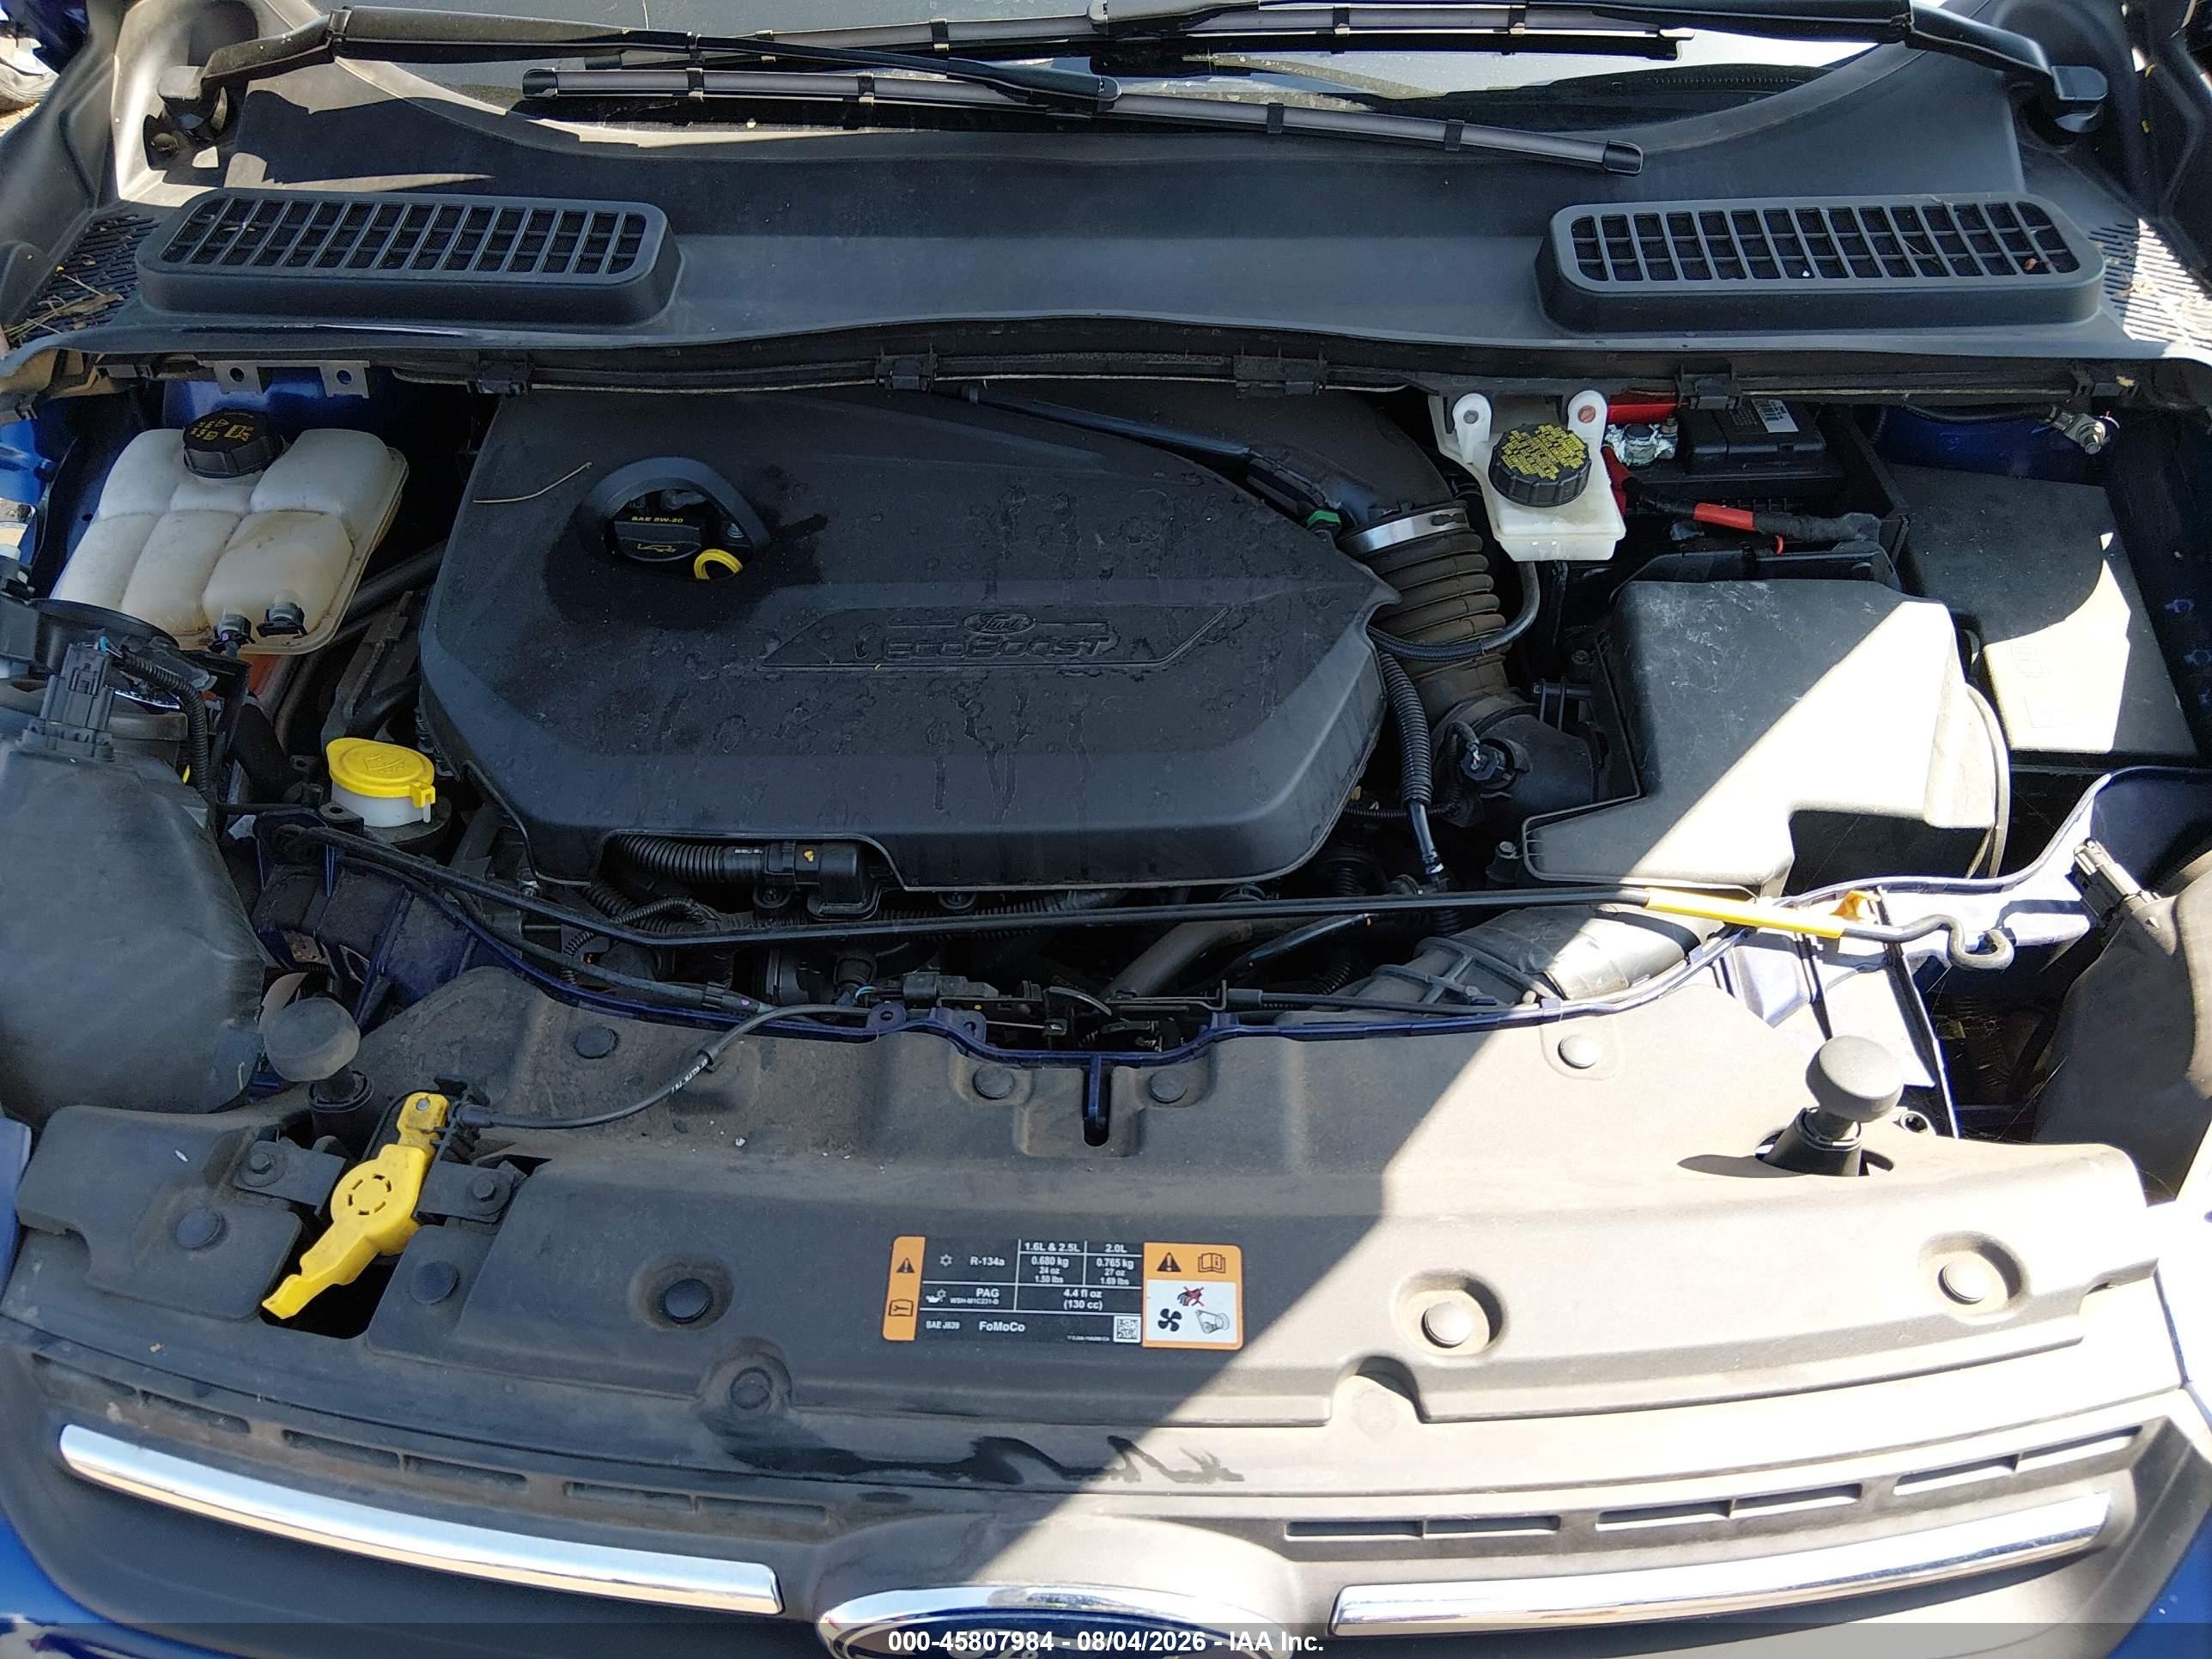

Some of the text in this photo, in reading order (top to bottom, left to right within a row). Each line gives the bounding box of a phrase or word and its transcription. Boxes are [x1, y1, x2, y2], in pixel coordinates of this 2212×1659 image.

[1024, 1242, 1080, 1253] 1.6L & 2.5L
[1105, 1243, 1127, 1253] 2.0L
[970, 1256, 1006, 1267] R-134a
[1030, 1255, 1069, 1267] 0.680 kg
[1096, 1258, 1134, 1270] 0.765 kg
[975, 1288, 1000, 1297] PAG
[1063, 1288, 1103, 1298] 4.4 fl oz
[1063, 1299, 1103, 1311] (130 cc)
[926, 1321, 941, 1329] SAE
[979, 1321, 1025, 1333] FoMoCo
